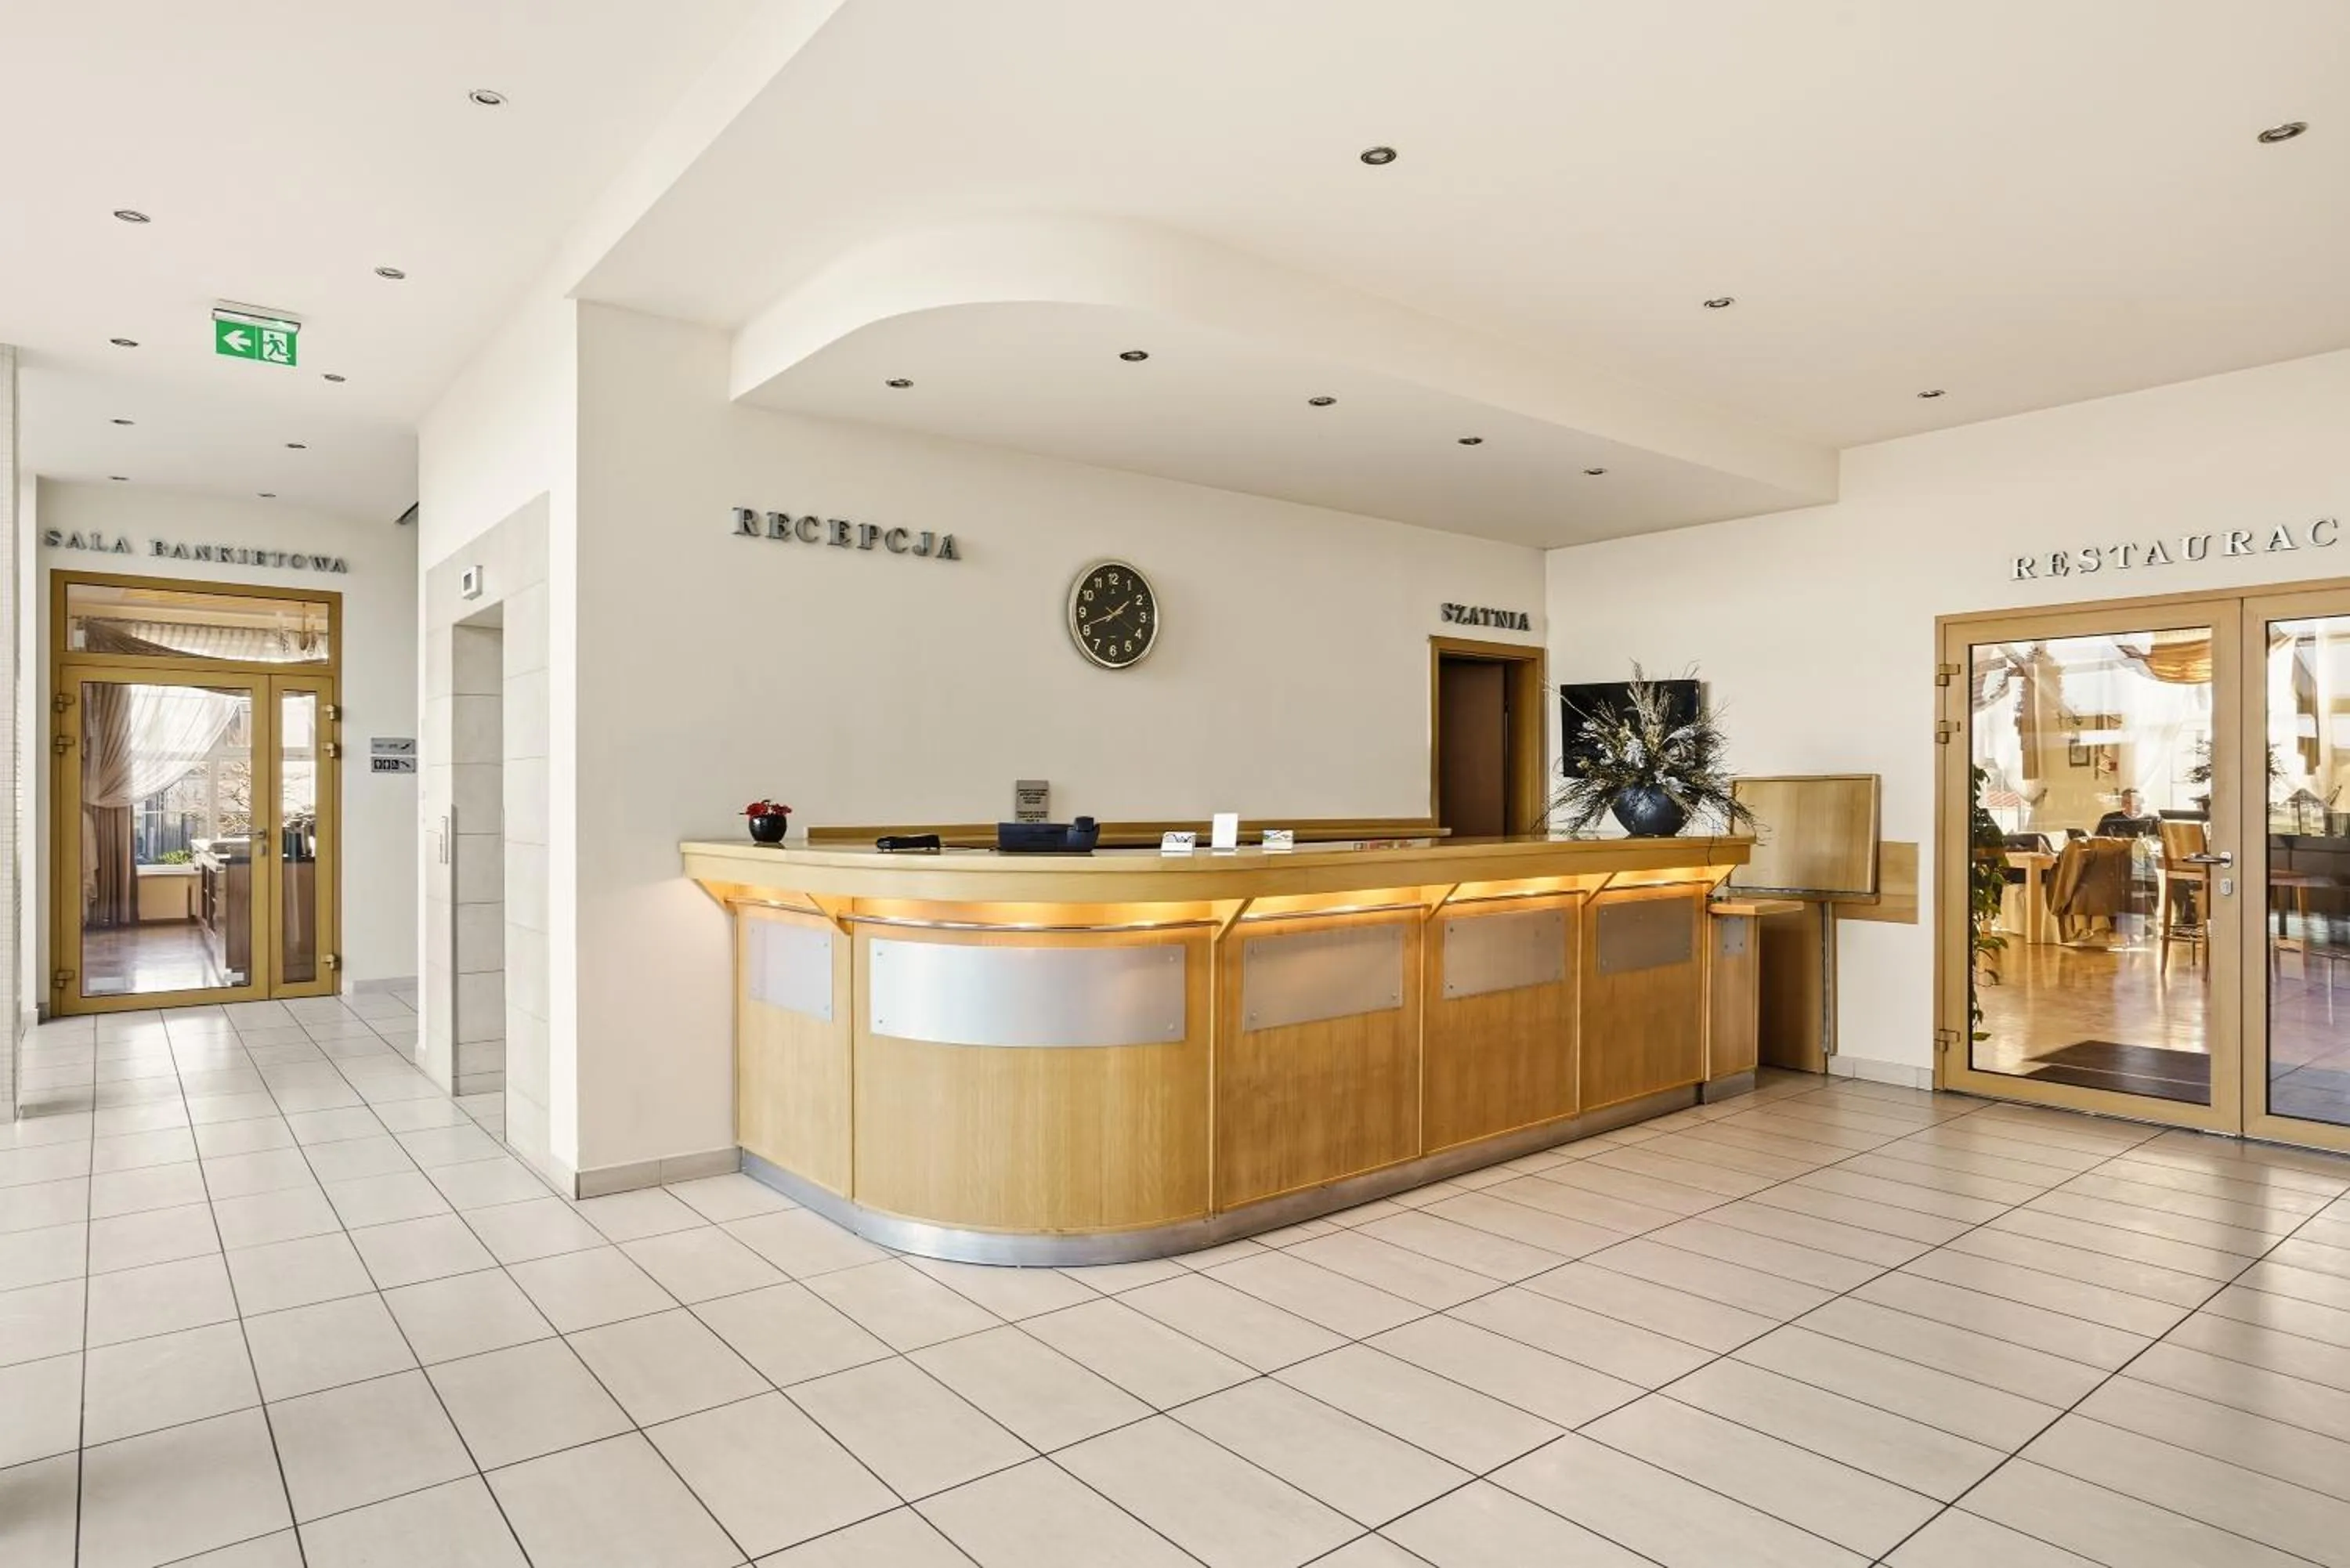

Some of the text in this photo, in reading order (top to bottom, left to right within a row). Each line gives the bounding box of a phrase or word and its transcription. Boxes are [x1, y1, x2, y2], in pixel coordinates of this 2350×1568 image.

[732, 507, 961, 560] RECEPCJA
[43, 529, 349, 573] SALA BANKIETOWA
[2010, 517, 2339, 580] RESTAURAC
[1094, 577, 1102, 588] 11
[1108, 573, 1119, 585] 12
[1126, 580, 1132, 591] 1
[1083, 590, 1094, 601] 10
[1136, 594, 1143, 605] 2
[1079, 606, 1086, 618] 9
[1140, 612, 1147, 623] 3
[1441, 602, 1531, 630] SZATNIA
[1083, 624, 1090, 636] 8
[1135, 628, 1141, 639] 4
[1094, 638, 1101, 650] 7
[1125, 640, 1132, 652] 5
[1109, 645, 1117, 656] 6
